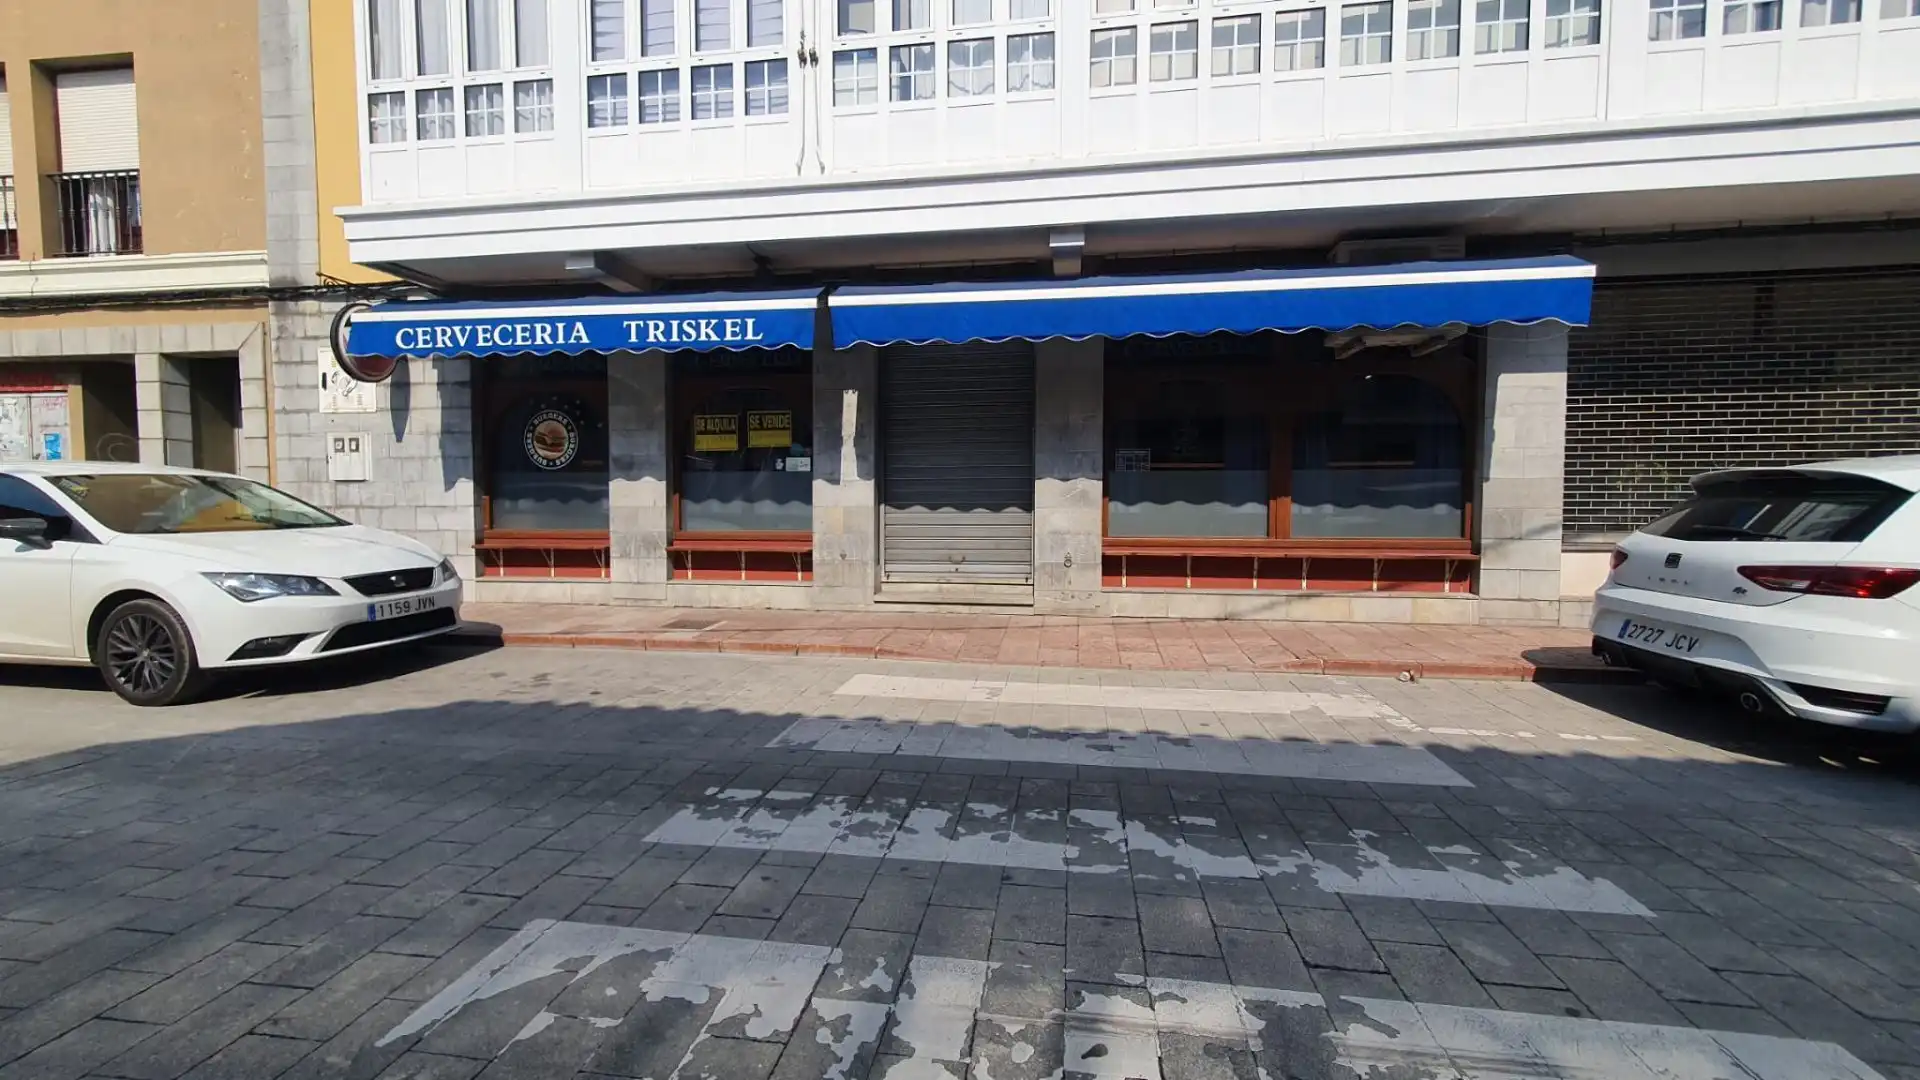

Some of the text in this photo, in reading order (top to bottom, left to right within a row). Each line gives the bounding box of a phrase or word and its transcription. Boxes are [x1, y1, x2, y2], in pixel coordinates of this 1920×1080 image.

[395, 318, 763, 349] CERVECERIA TRISKEL
[697, 416, 736, 433] SE ALQUILA
[749, 414, 790, 429] SE VENDE
[379, 595, 435, 618] 1159 JVN
[1627, 623, 1700, 652] 2727 JCV
